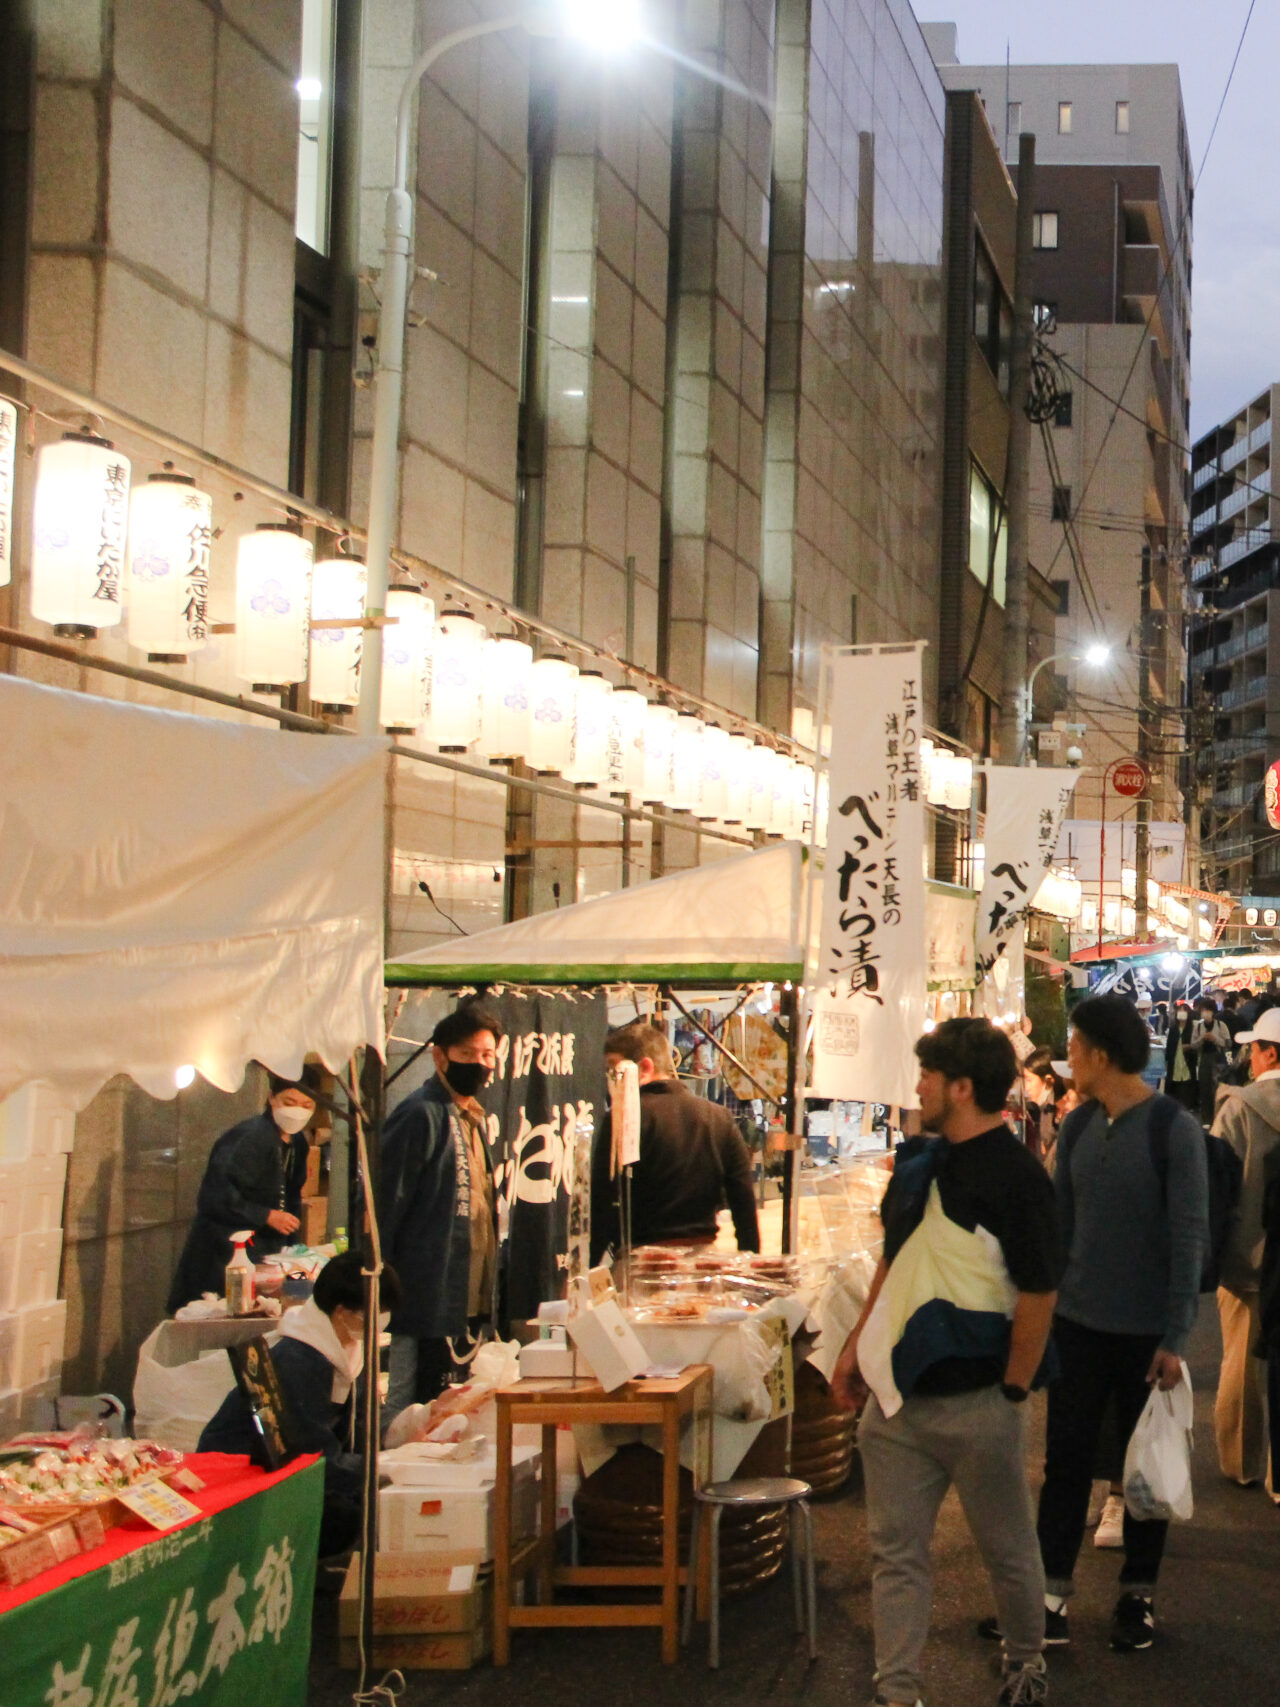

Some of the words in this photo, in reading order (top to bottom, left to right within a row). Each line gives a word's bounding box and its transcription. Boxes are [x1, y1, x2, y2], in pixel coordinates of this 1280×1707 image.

[899, 679, 919, 802] 江戸の王者
[1114, 772, 1143, 787] 消火栓
[828, 790, 885, 1006] べったら漬
